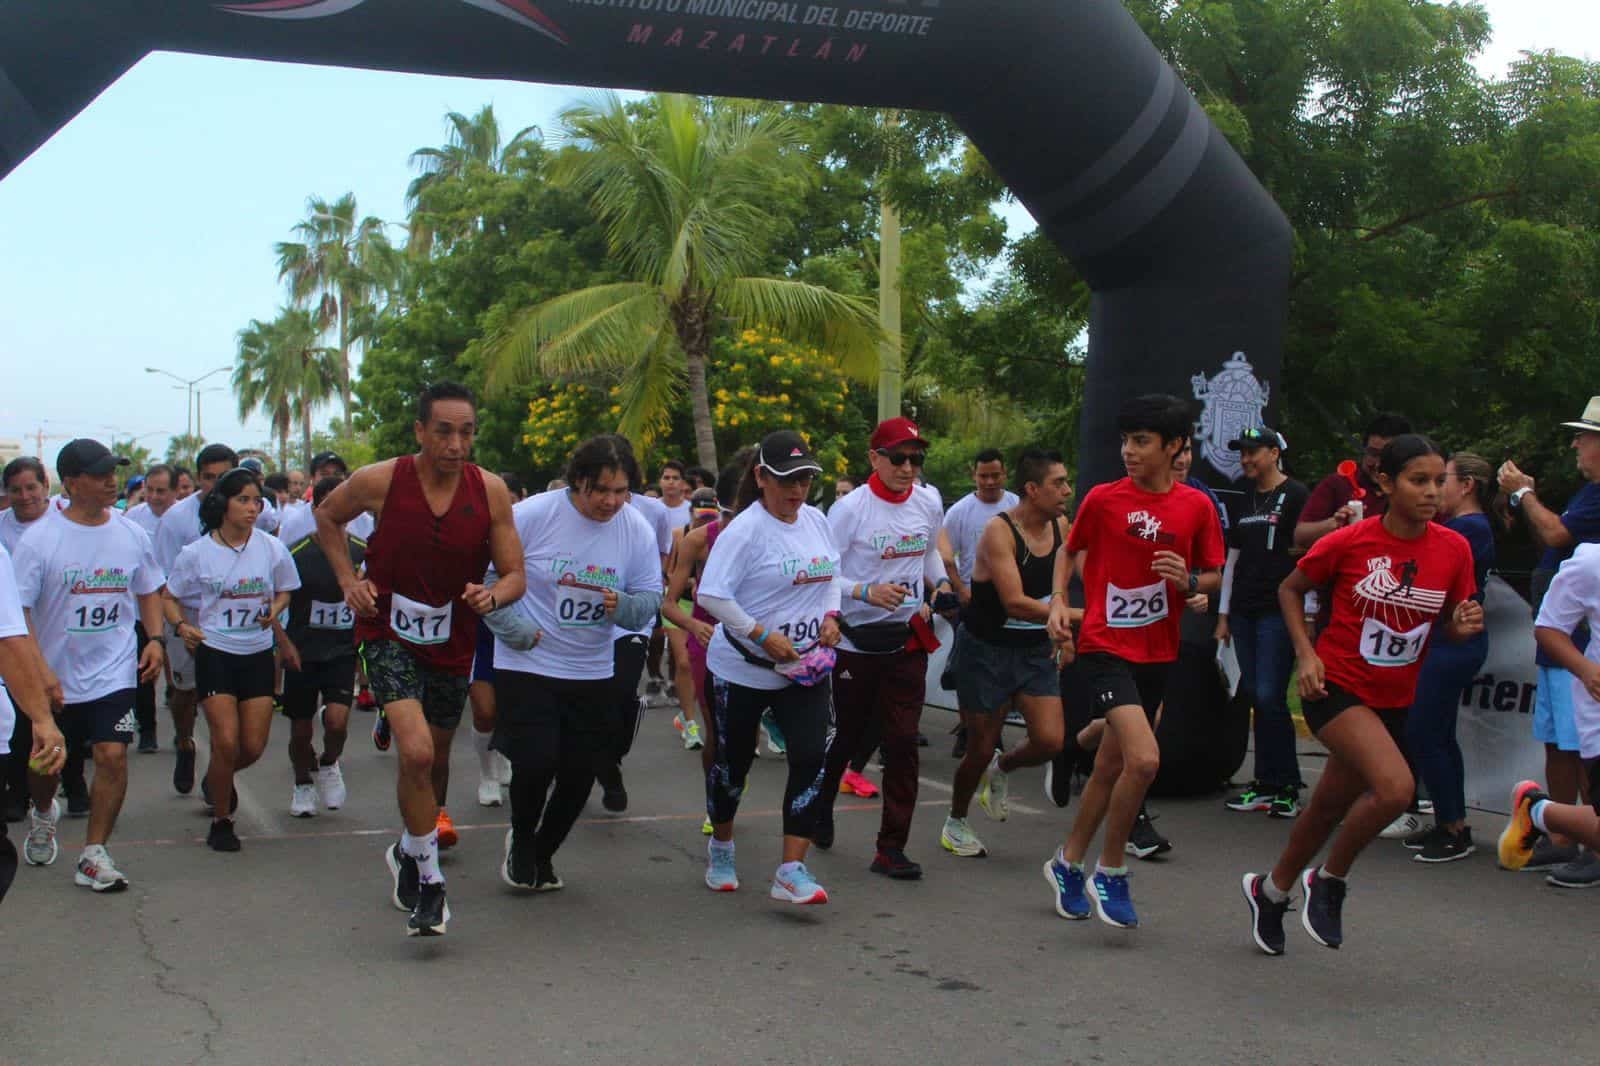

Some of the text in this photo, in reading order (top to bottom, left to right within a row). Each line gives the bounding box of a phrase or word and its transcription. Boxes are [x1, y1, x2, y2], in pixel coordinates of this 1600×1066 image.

[686, 0, 800, 24] MUNICIPAL
[802, 5, 840, 27] DEL
[844, 10, 934, 36] DEPORTE
[75, 602, 120, 628] 194
[315, 606, 353, 625] 113
[560, 597, 606, 620] 028
[1111, 591, 1164, 619] 226
[395, 609, 447, 638] 017
[778, 616, 821, 642] 190
[1369, 629, 1424, 657] 181
